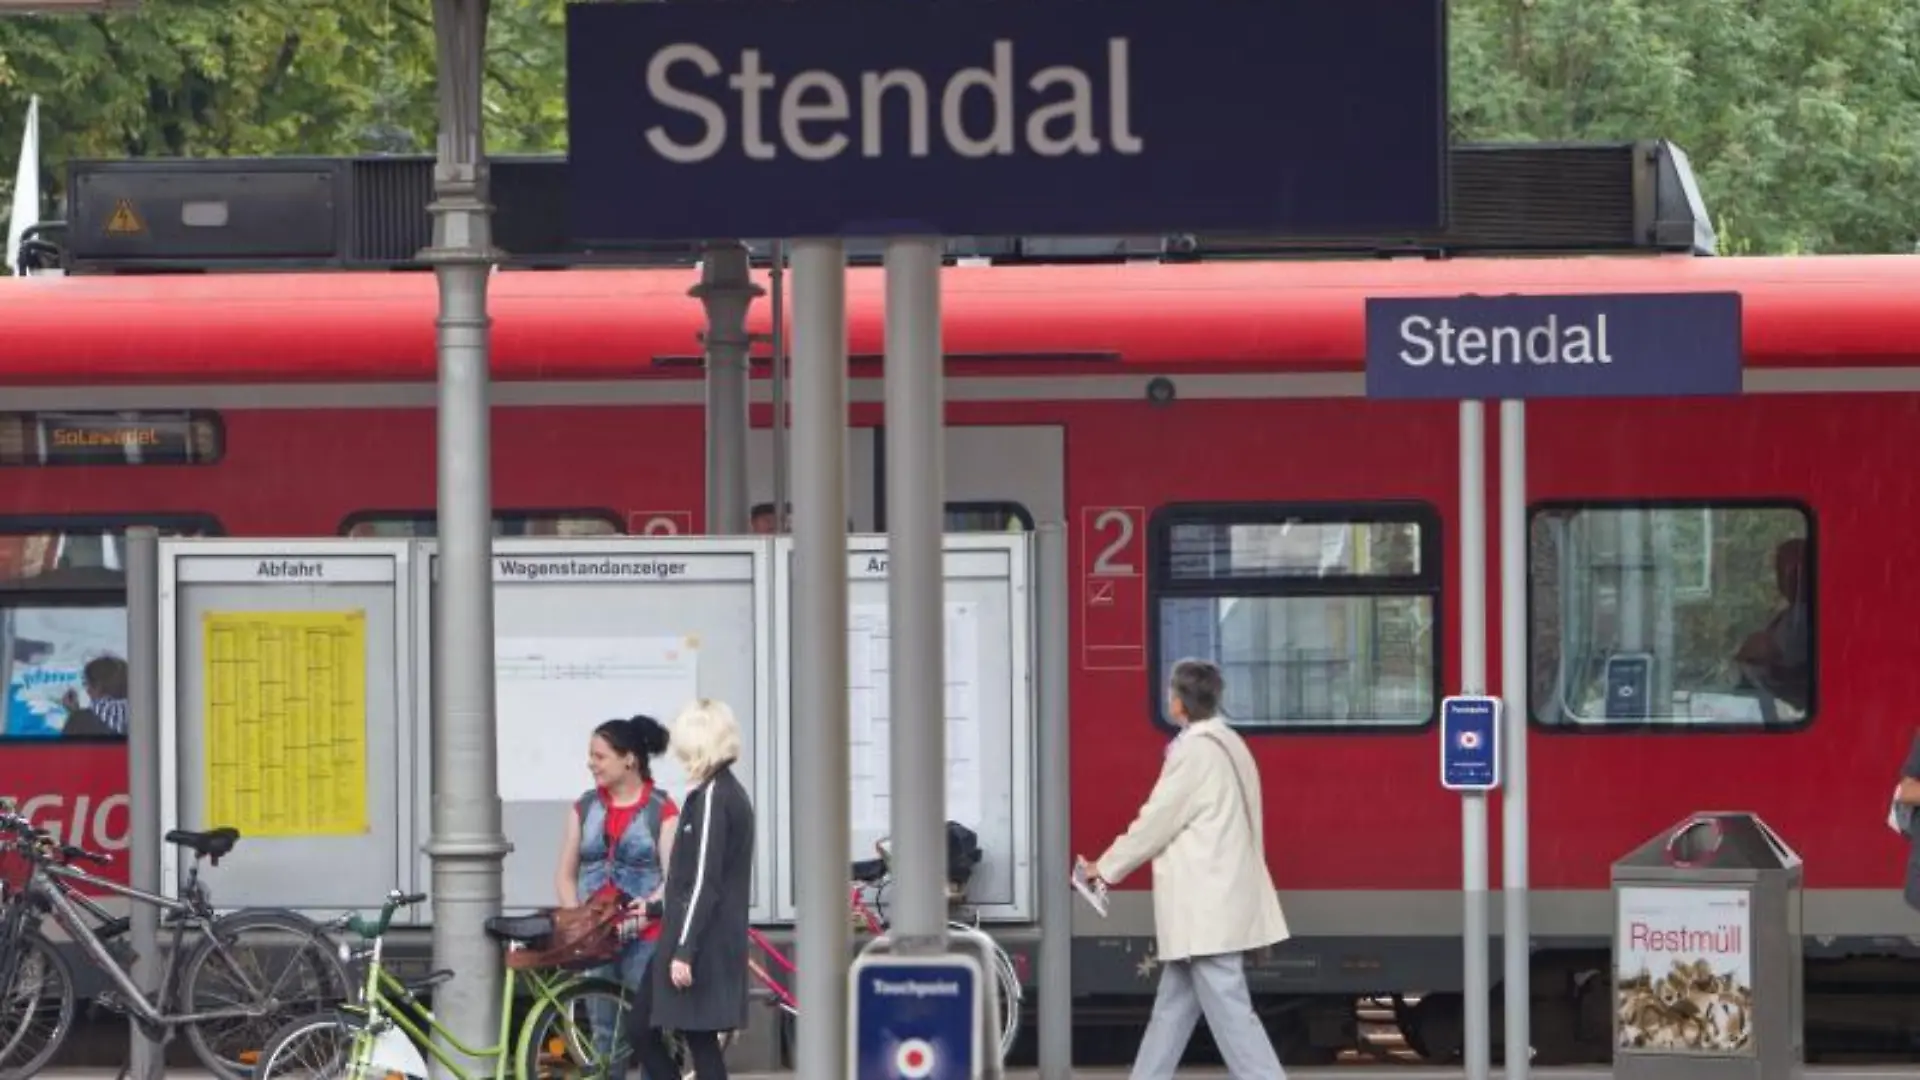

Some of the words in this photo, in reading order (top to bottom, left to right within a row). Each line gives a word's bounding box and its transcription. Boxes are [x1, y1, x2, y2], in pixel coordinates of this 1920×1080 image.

[645, 37, 1144, 162] Stendal
[1398, 313, 1613, 366] Stendal
[1094, 510, 1134, 573] 2
[257, 560, 324, 577] Abfahrt
[500, 559, 688, 579] Wagenstandanzeiger
[1630, 921, 1742, 954] Restmüll
